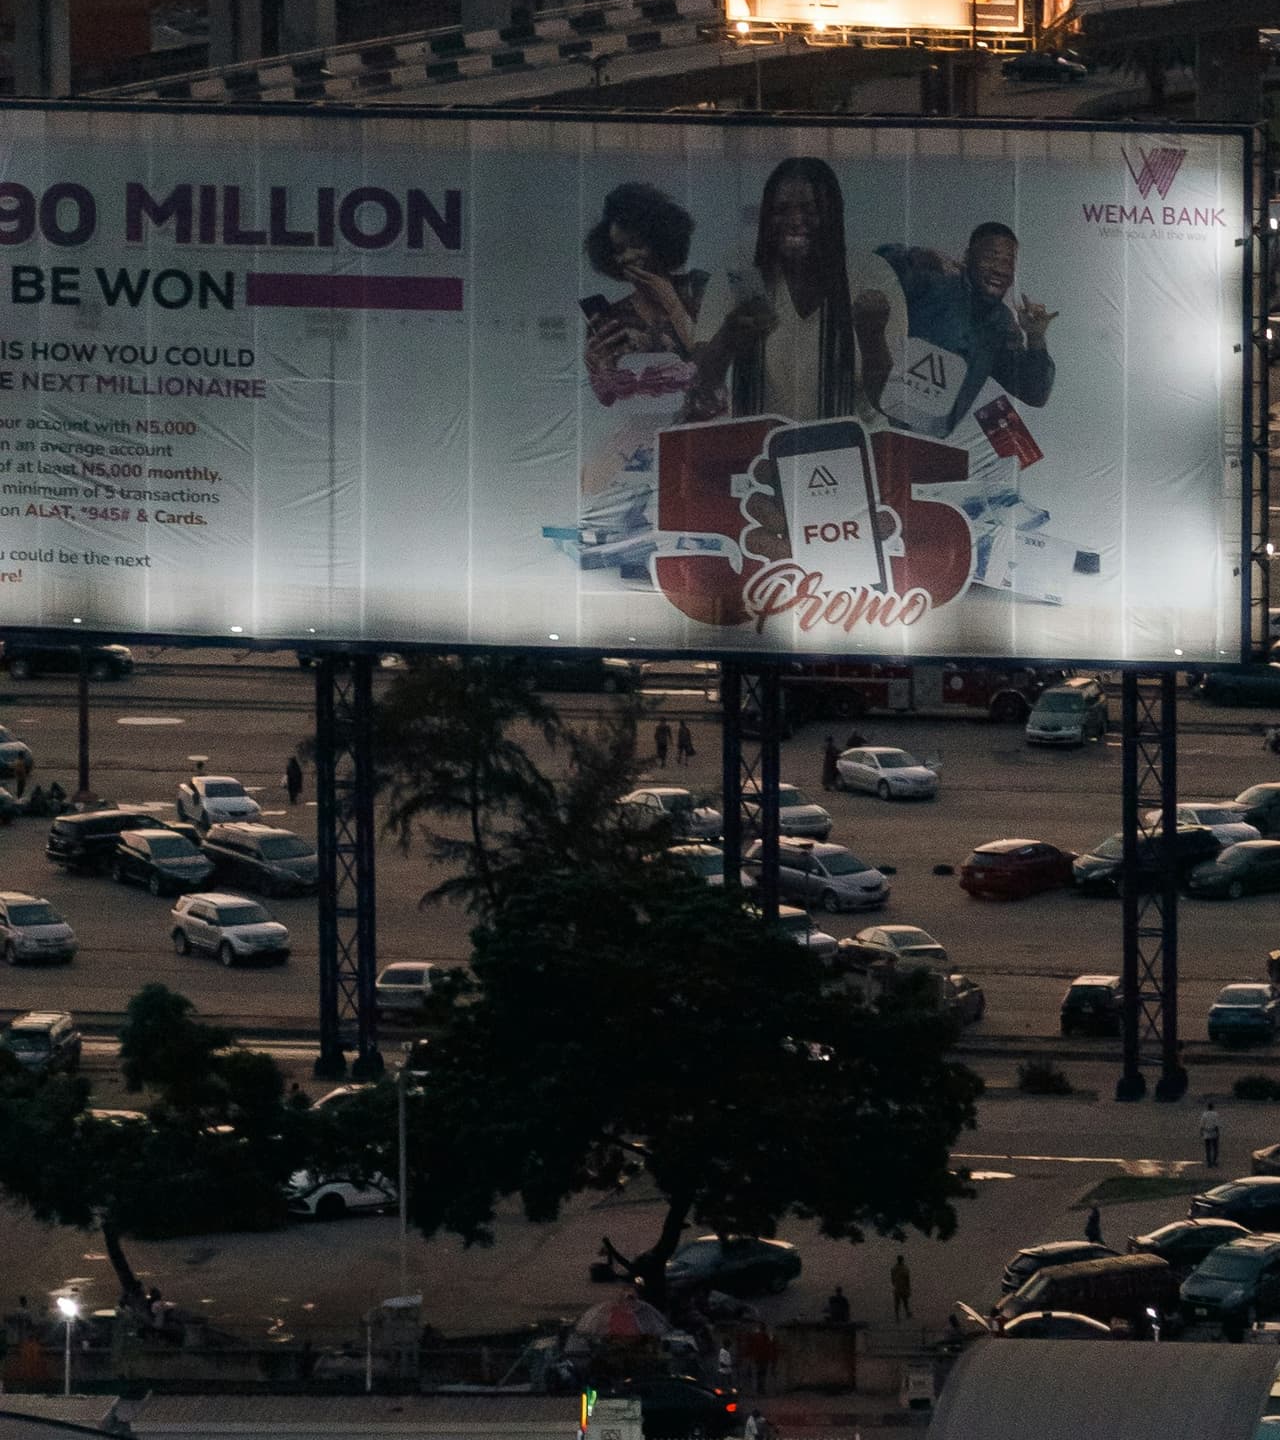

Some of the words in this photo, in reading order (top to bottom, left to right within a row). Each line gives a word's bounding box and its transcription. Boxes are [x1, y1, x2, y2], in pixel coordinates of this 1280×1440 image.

[125, 182, 462, 251] MILLION
[1082, 203, 1155, 225] WEMA
[1162, 206, 1226, 227] BANK
[11, 265, 80, 306] BE
[94, 268, 235, 310] WON
[31, 341, 97, 362] HOW
[103, 344, 158, 365] YOU
[164, 346, 256, 368] COULD
[22, 373, 92, 394] NEXT
[96, 374, 268, 399] MILLIONAIRE
[26, 419, 90, 432] account
[94, 420, 131, 432] with
[16, 441, 36, 452] an
[41, 442, 106, 458] average
[109, 445, 173, 458] account
[17, 462, 34, 474] at
[38, 460, 79, 476] least
[148, 466, 223, 485] monthly.
[3, 481, 79, 497] minimum
[83, 484, 99, 499] of
[119, 487, 221, 504] transactions
[136, 508, 149, 523] &
[155, 510, 208, 526] Cards.
[804, 521, 860, 545] FOR
[10, 548, 54, 562] could
[59, 549, 80, 564] be
[84, 551, 110, 566] the
[115, 554, 152, 568] next
[743, 562, 932, 635] Promo
